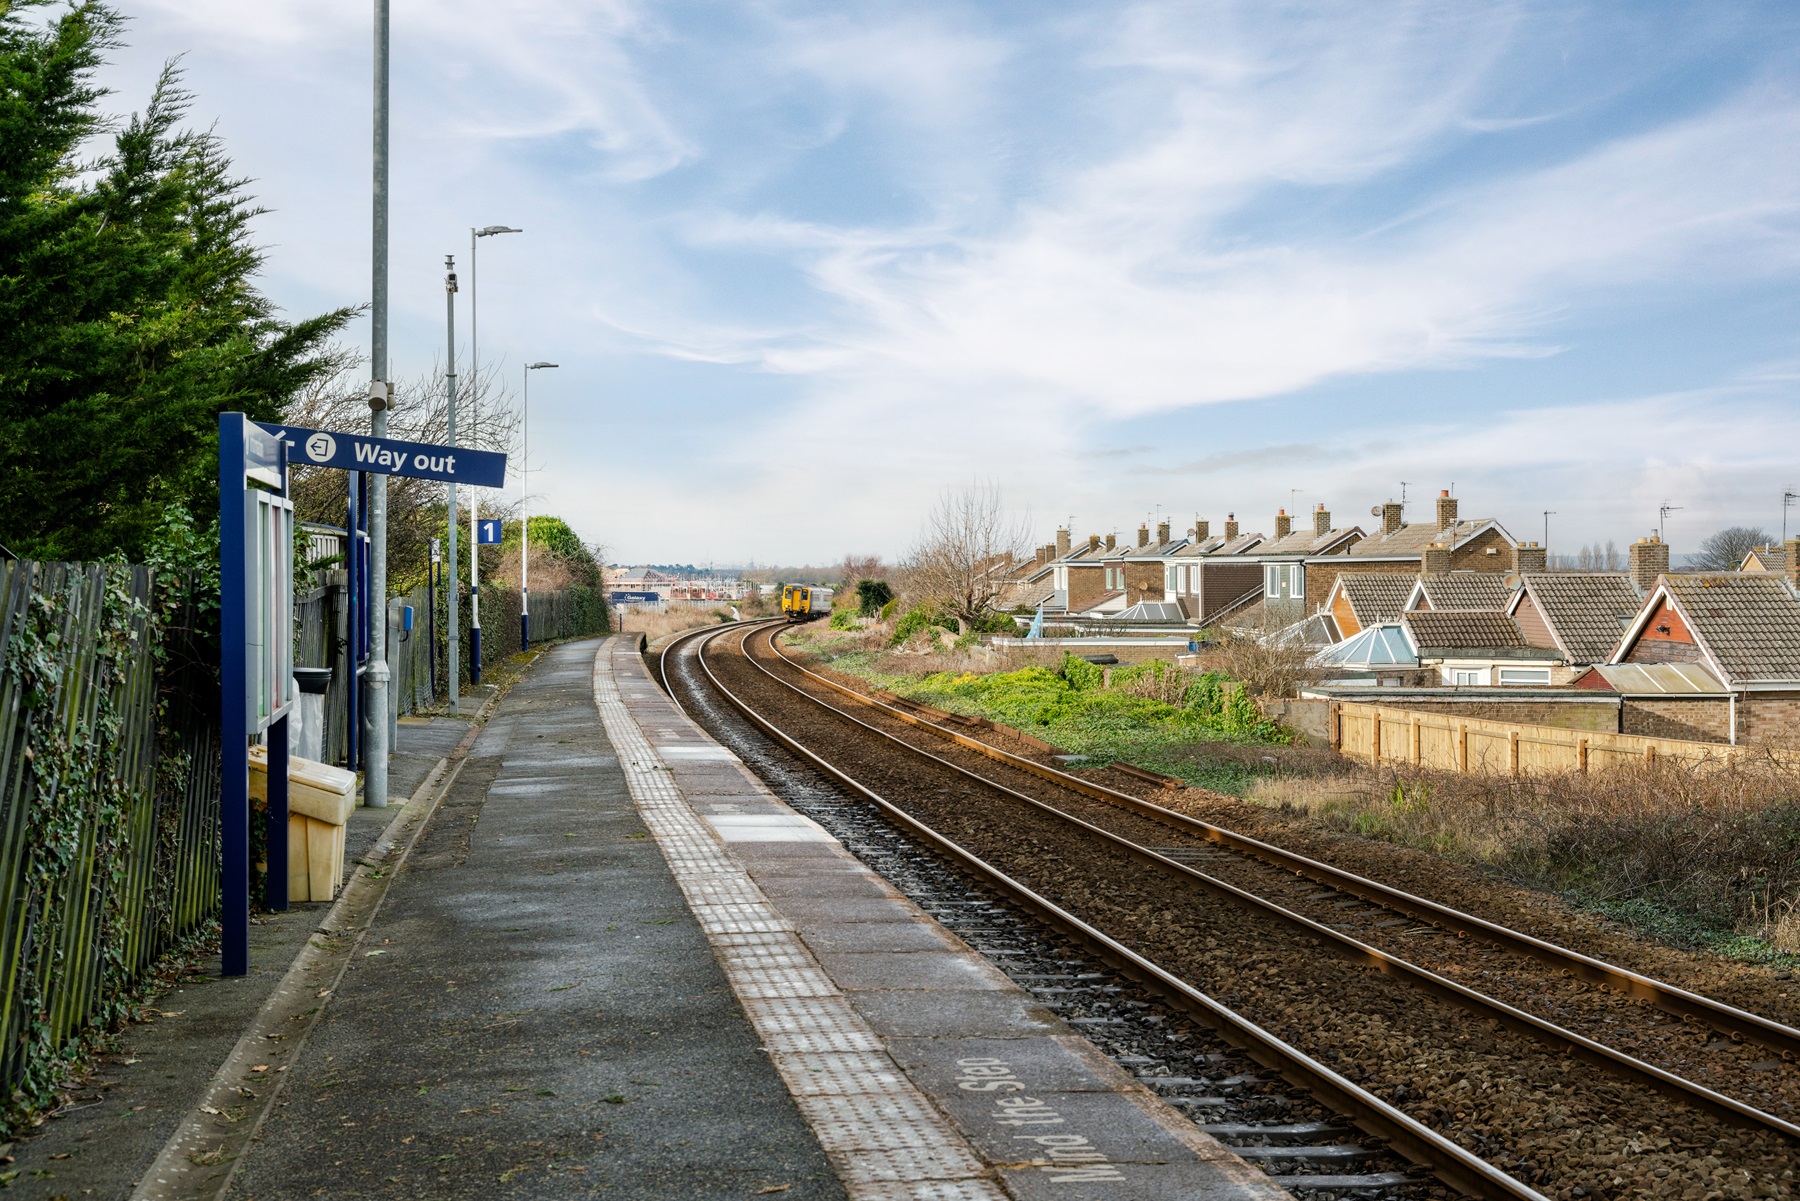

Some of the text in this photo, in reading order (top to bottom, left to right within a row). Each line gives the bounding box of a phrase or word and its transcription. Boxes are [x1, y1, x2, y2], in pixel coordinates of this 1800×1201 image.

[354, 442, 456, 474] Way out
[483, 522, 494, 542] 1
[991, 1096, 1065, 1126] the
[1012, 1134, 1126, 1183] Mind
